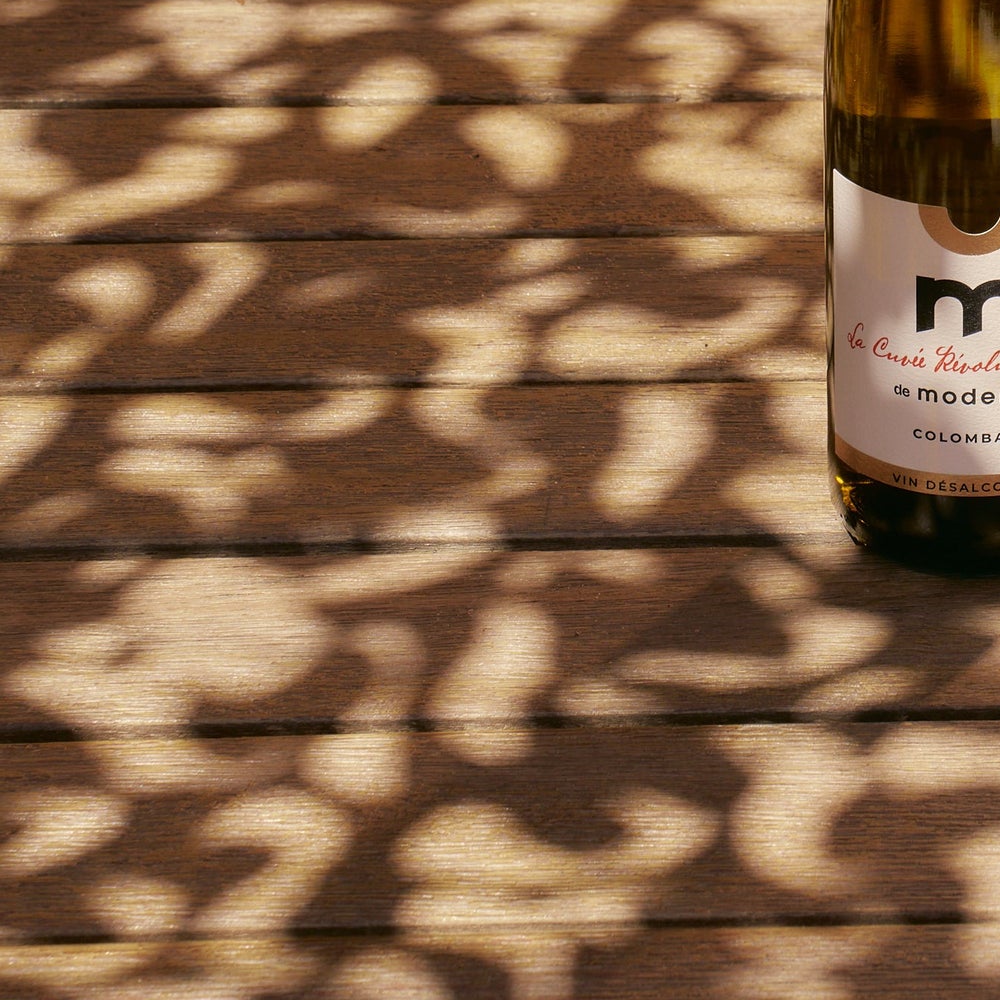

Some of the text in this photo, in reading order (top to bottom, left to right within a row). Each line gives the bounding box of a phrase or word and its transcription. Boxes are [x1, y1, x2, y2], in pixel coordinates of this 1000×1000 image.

[847, 322, 866, 349] La
[872, 337, 926, 369] Cuvée
[893, 384, 911, 399] de
[892, 472, 919, 488] VIN
